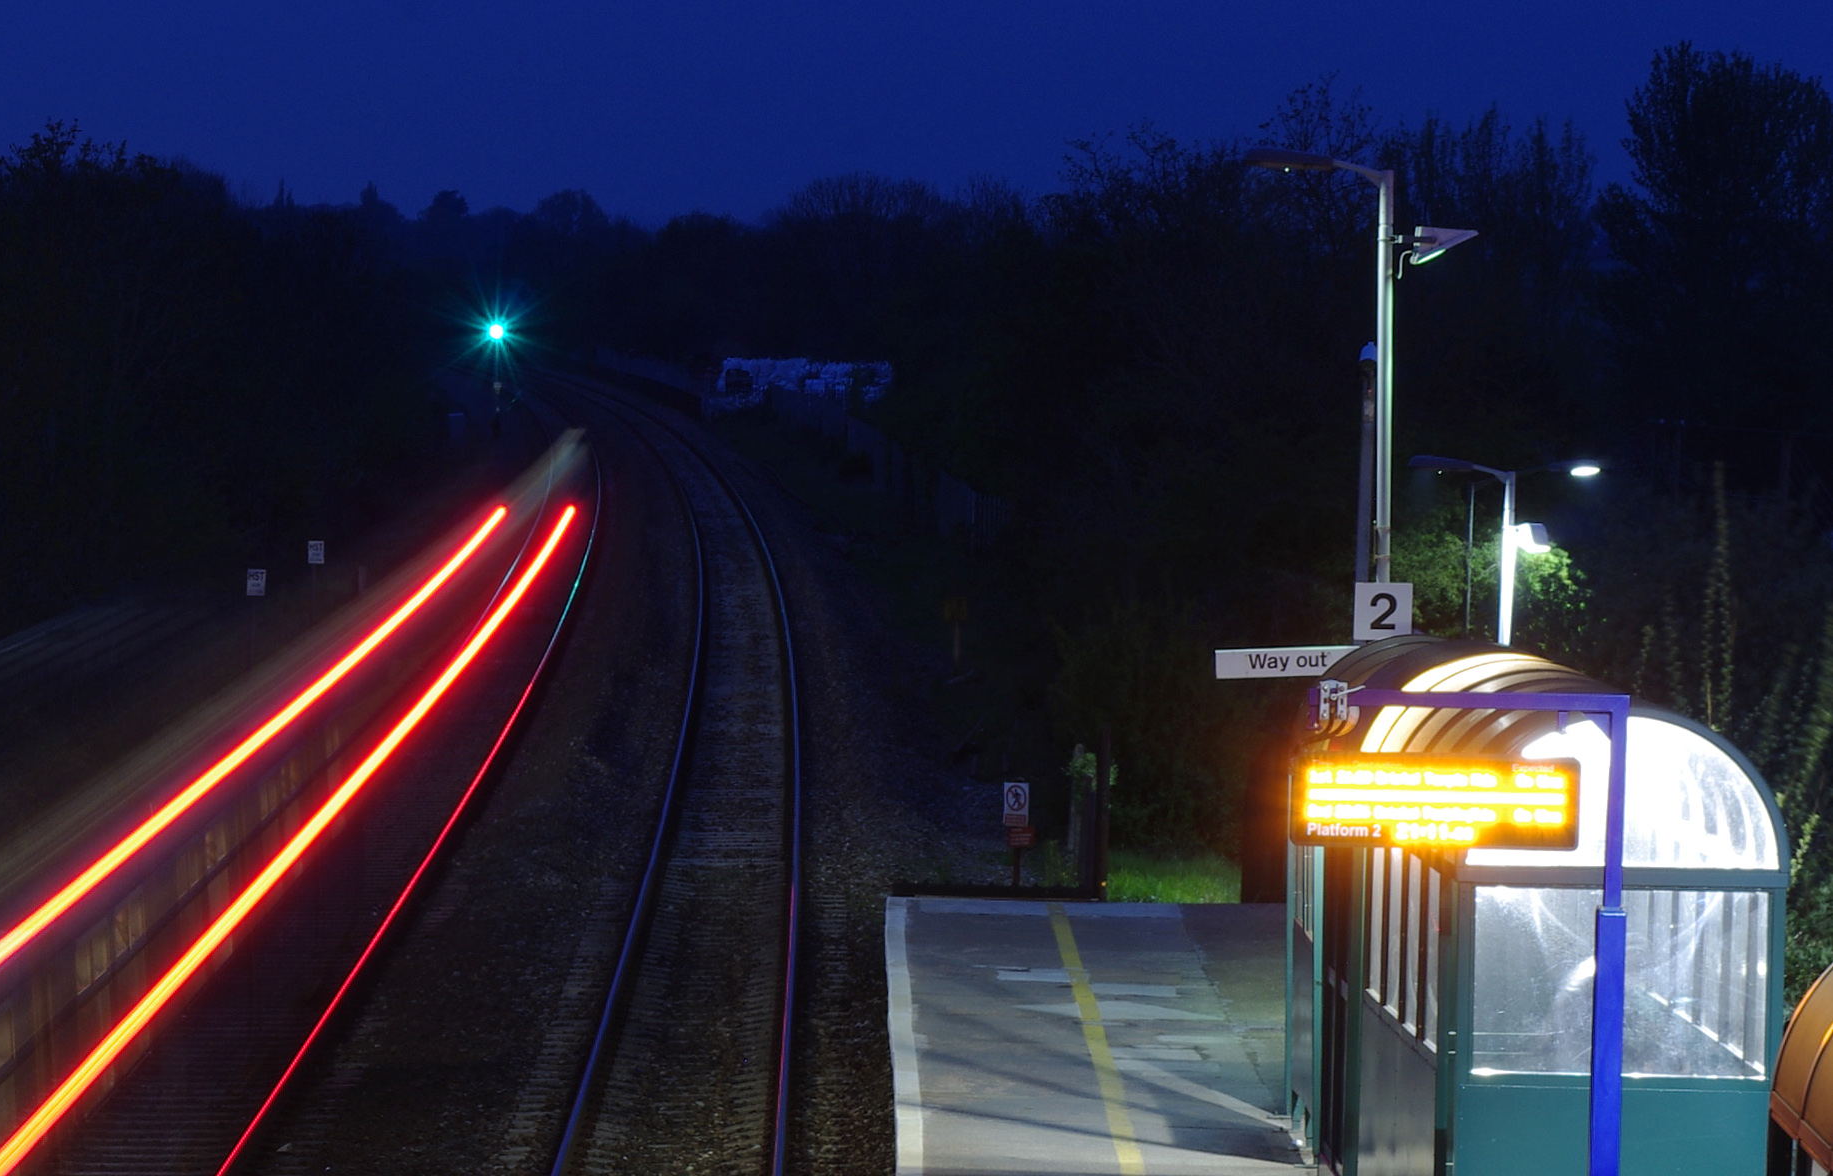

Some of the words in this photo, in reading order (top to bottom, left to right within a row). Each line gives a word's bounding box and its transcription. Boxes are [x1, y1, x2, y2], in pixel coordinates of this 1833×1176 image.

[1370, 593, 1397, 630] 2
[1248, 653, 1290, 671] Way
[1296, 652, 1328, 668] out
[1307, 823, 1369, 838] Platform
[1372, 824, 1382, 838] 2
